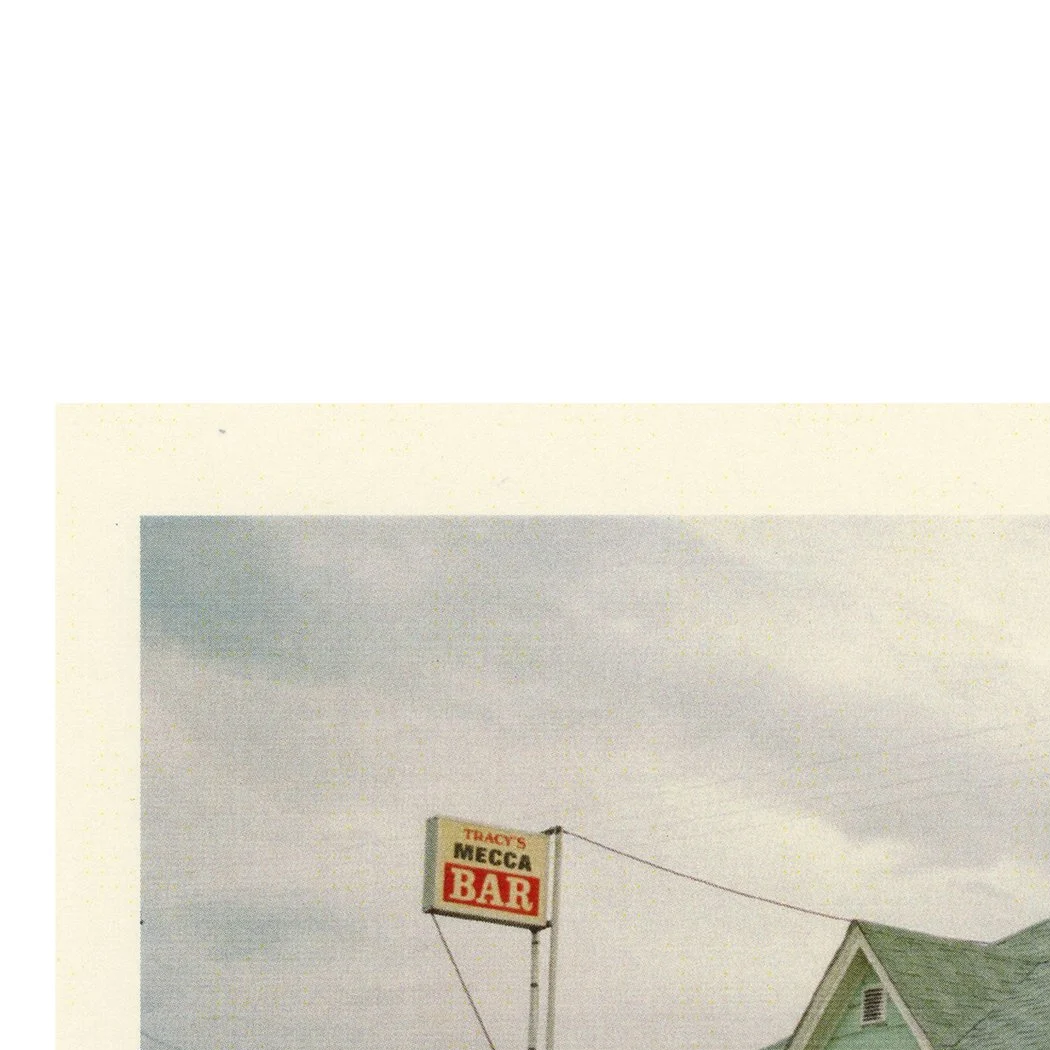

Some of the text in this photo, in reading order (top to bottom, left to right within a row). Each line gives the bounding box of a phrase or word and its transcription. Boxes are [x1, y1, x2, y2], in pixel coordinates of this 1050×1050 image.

[463, 828, 528, 849] TRACY'S
[453, 841, 533, 872] MECCA
[449, 867, 534, 912] BAR
